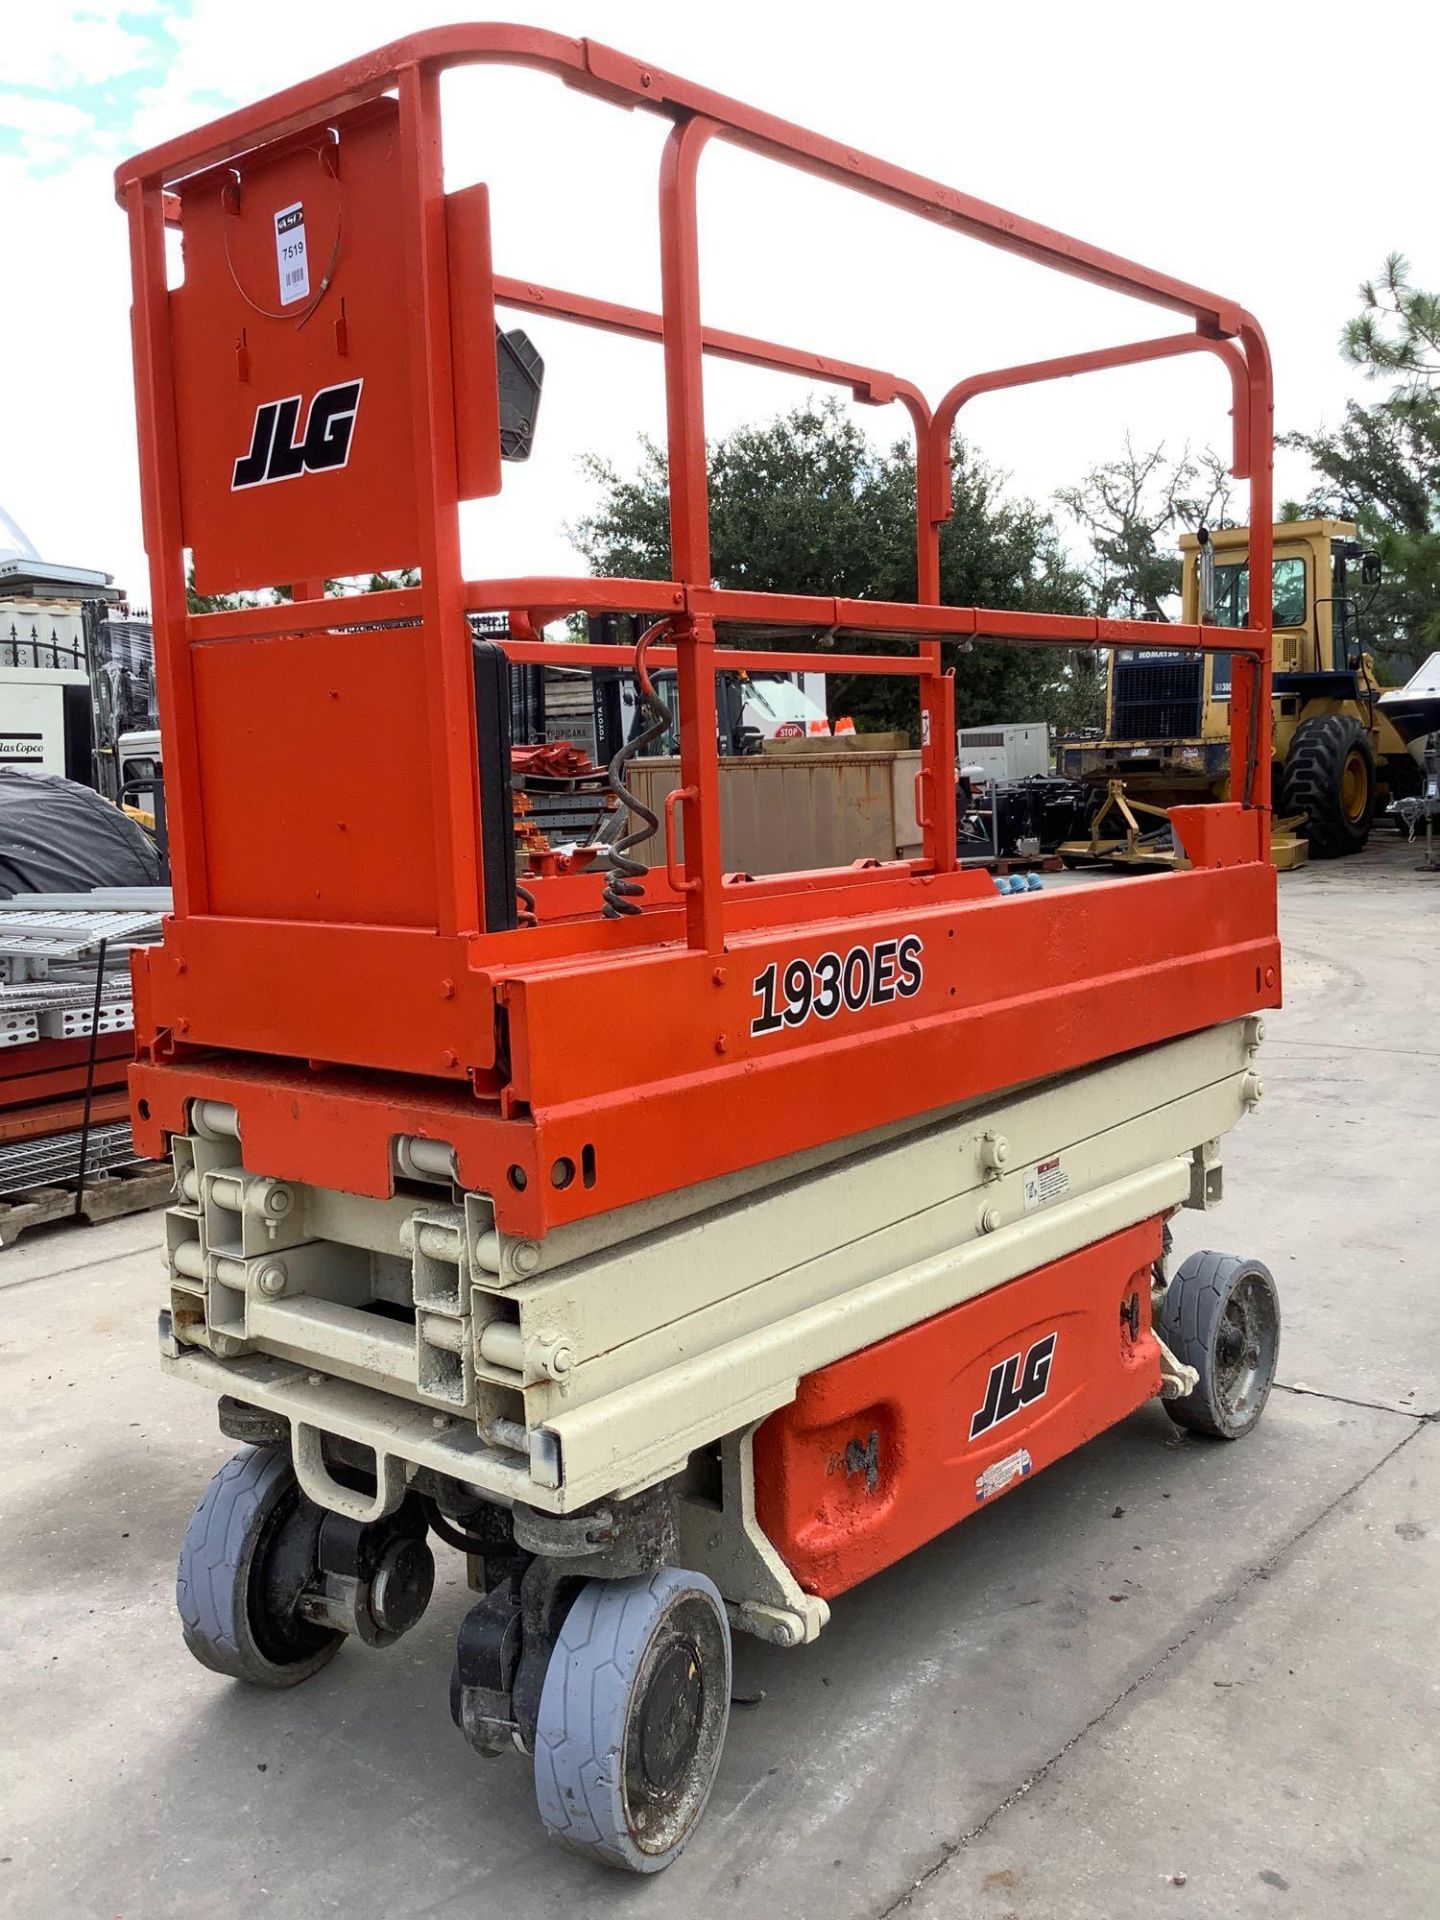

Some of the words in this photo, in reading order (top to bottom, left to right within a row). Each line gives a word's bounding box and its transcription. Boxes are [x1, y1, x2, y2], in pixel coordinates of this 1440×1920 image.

[282, 241, 304, 261] 7519
[231, 378, 363, 491] JLG
[597, 707, 605, 742] TOYOTA
[780, 728, 798, 737] STOP
[751, 934, 923, 1037] 1930ES
[968, 1331, 1059, 1442] JLG
